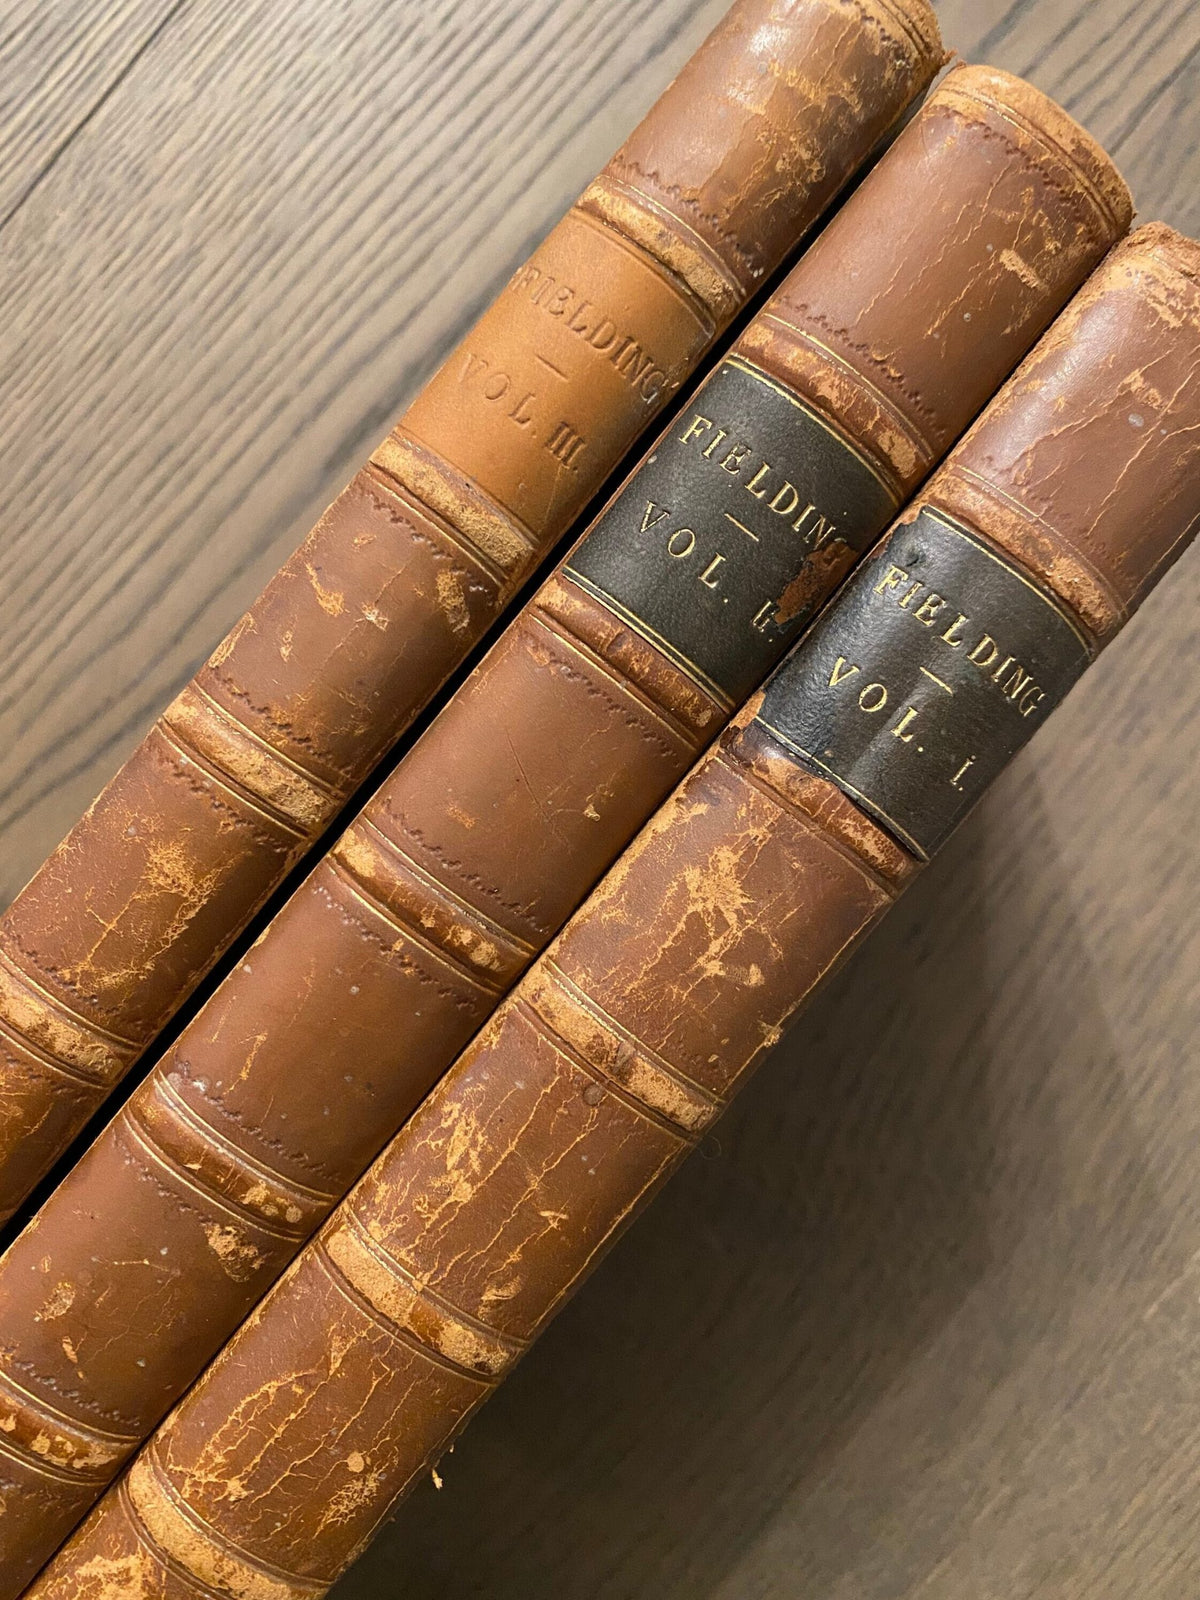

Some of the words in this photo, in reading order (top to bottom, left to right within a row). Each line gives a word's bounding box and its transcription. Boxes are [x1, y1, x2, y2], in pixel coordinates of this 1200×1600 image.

[457, 353, 537, 438] VOL.
[544, 420, 586, 473] III.
[678, 414, 847, 553] FIELDIN
[639, 501, 729, 604] VOL.
[873, 564, 1046, 718] FIELDING
[828, 656, 924, 753] VOL.
